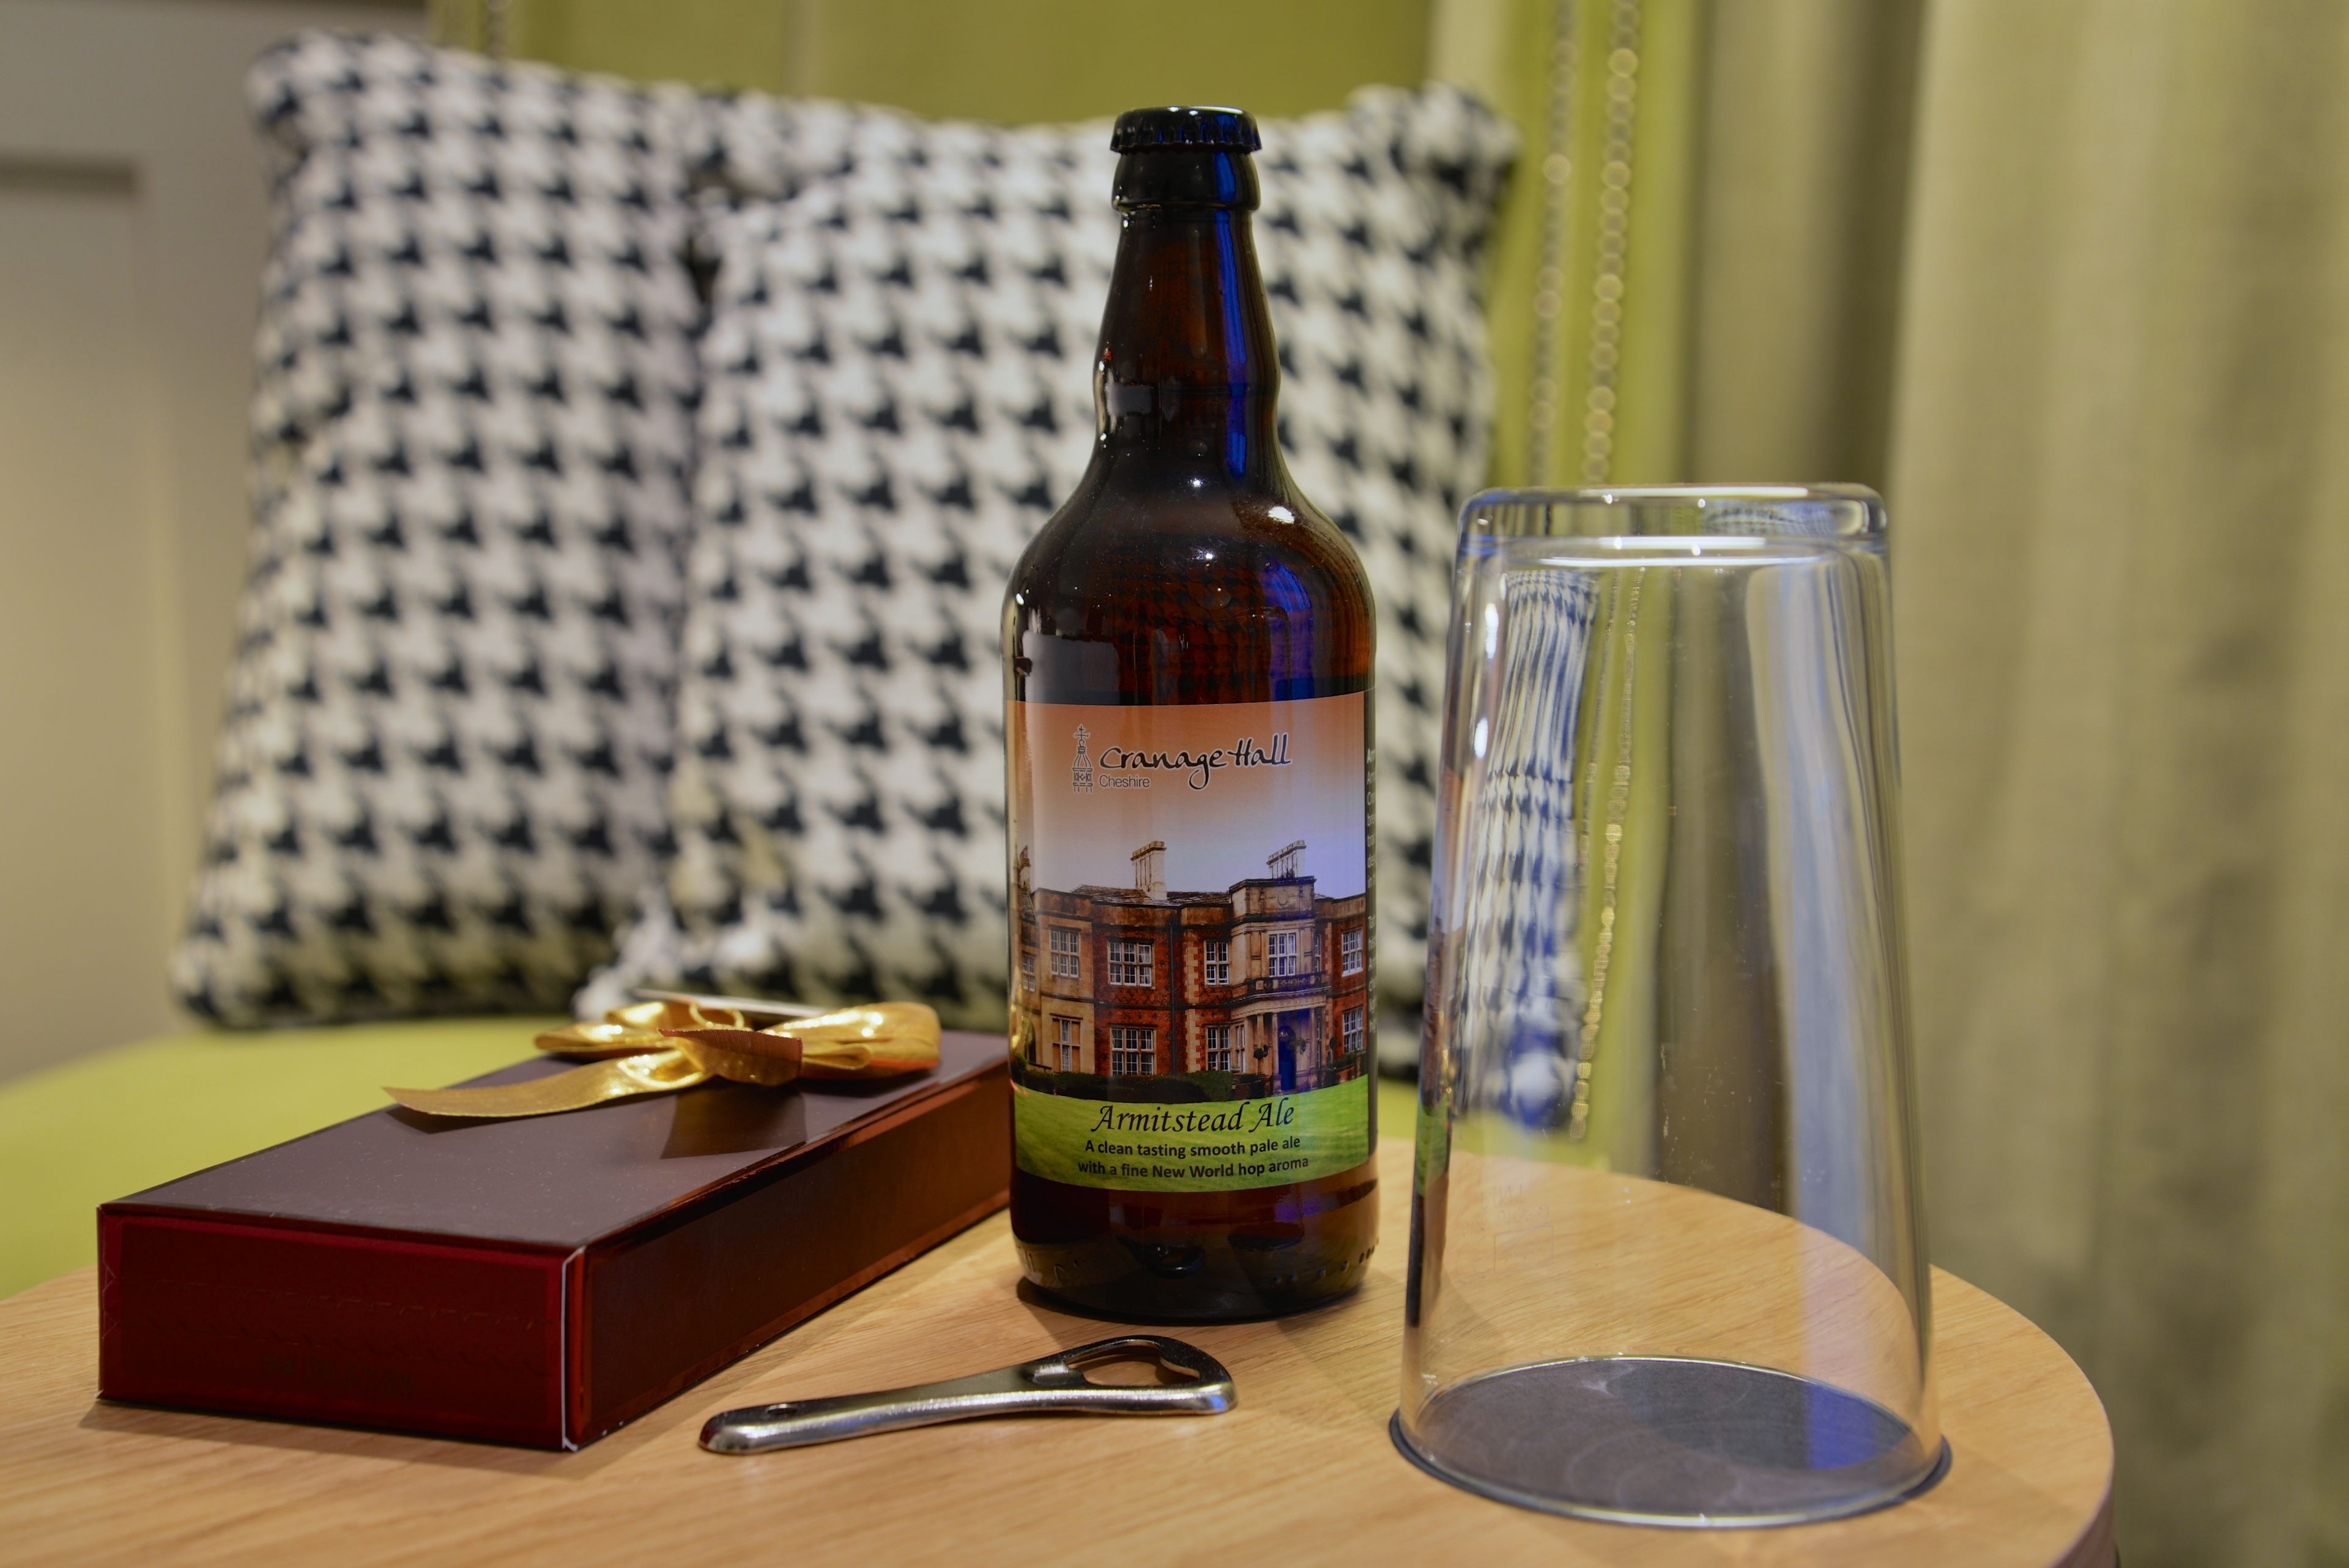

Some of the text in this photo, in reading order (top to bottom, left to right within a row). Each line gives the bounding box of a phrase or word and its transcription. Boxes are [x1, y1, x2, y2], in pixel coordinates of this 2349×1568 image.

[1100, 734, 1291, 790] Cranage Hall
[1099, 775, 1150, 787] Cheshire
[1091, 1097, 1294, 1132] Armitstead Ale
[1085, 1136, 1301, 1159] A clean tasting smooth pale ale
[1078, 1158, 1309, 1178] with a fine New World hop aroma
